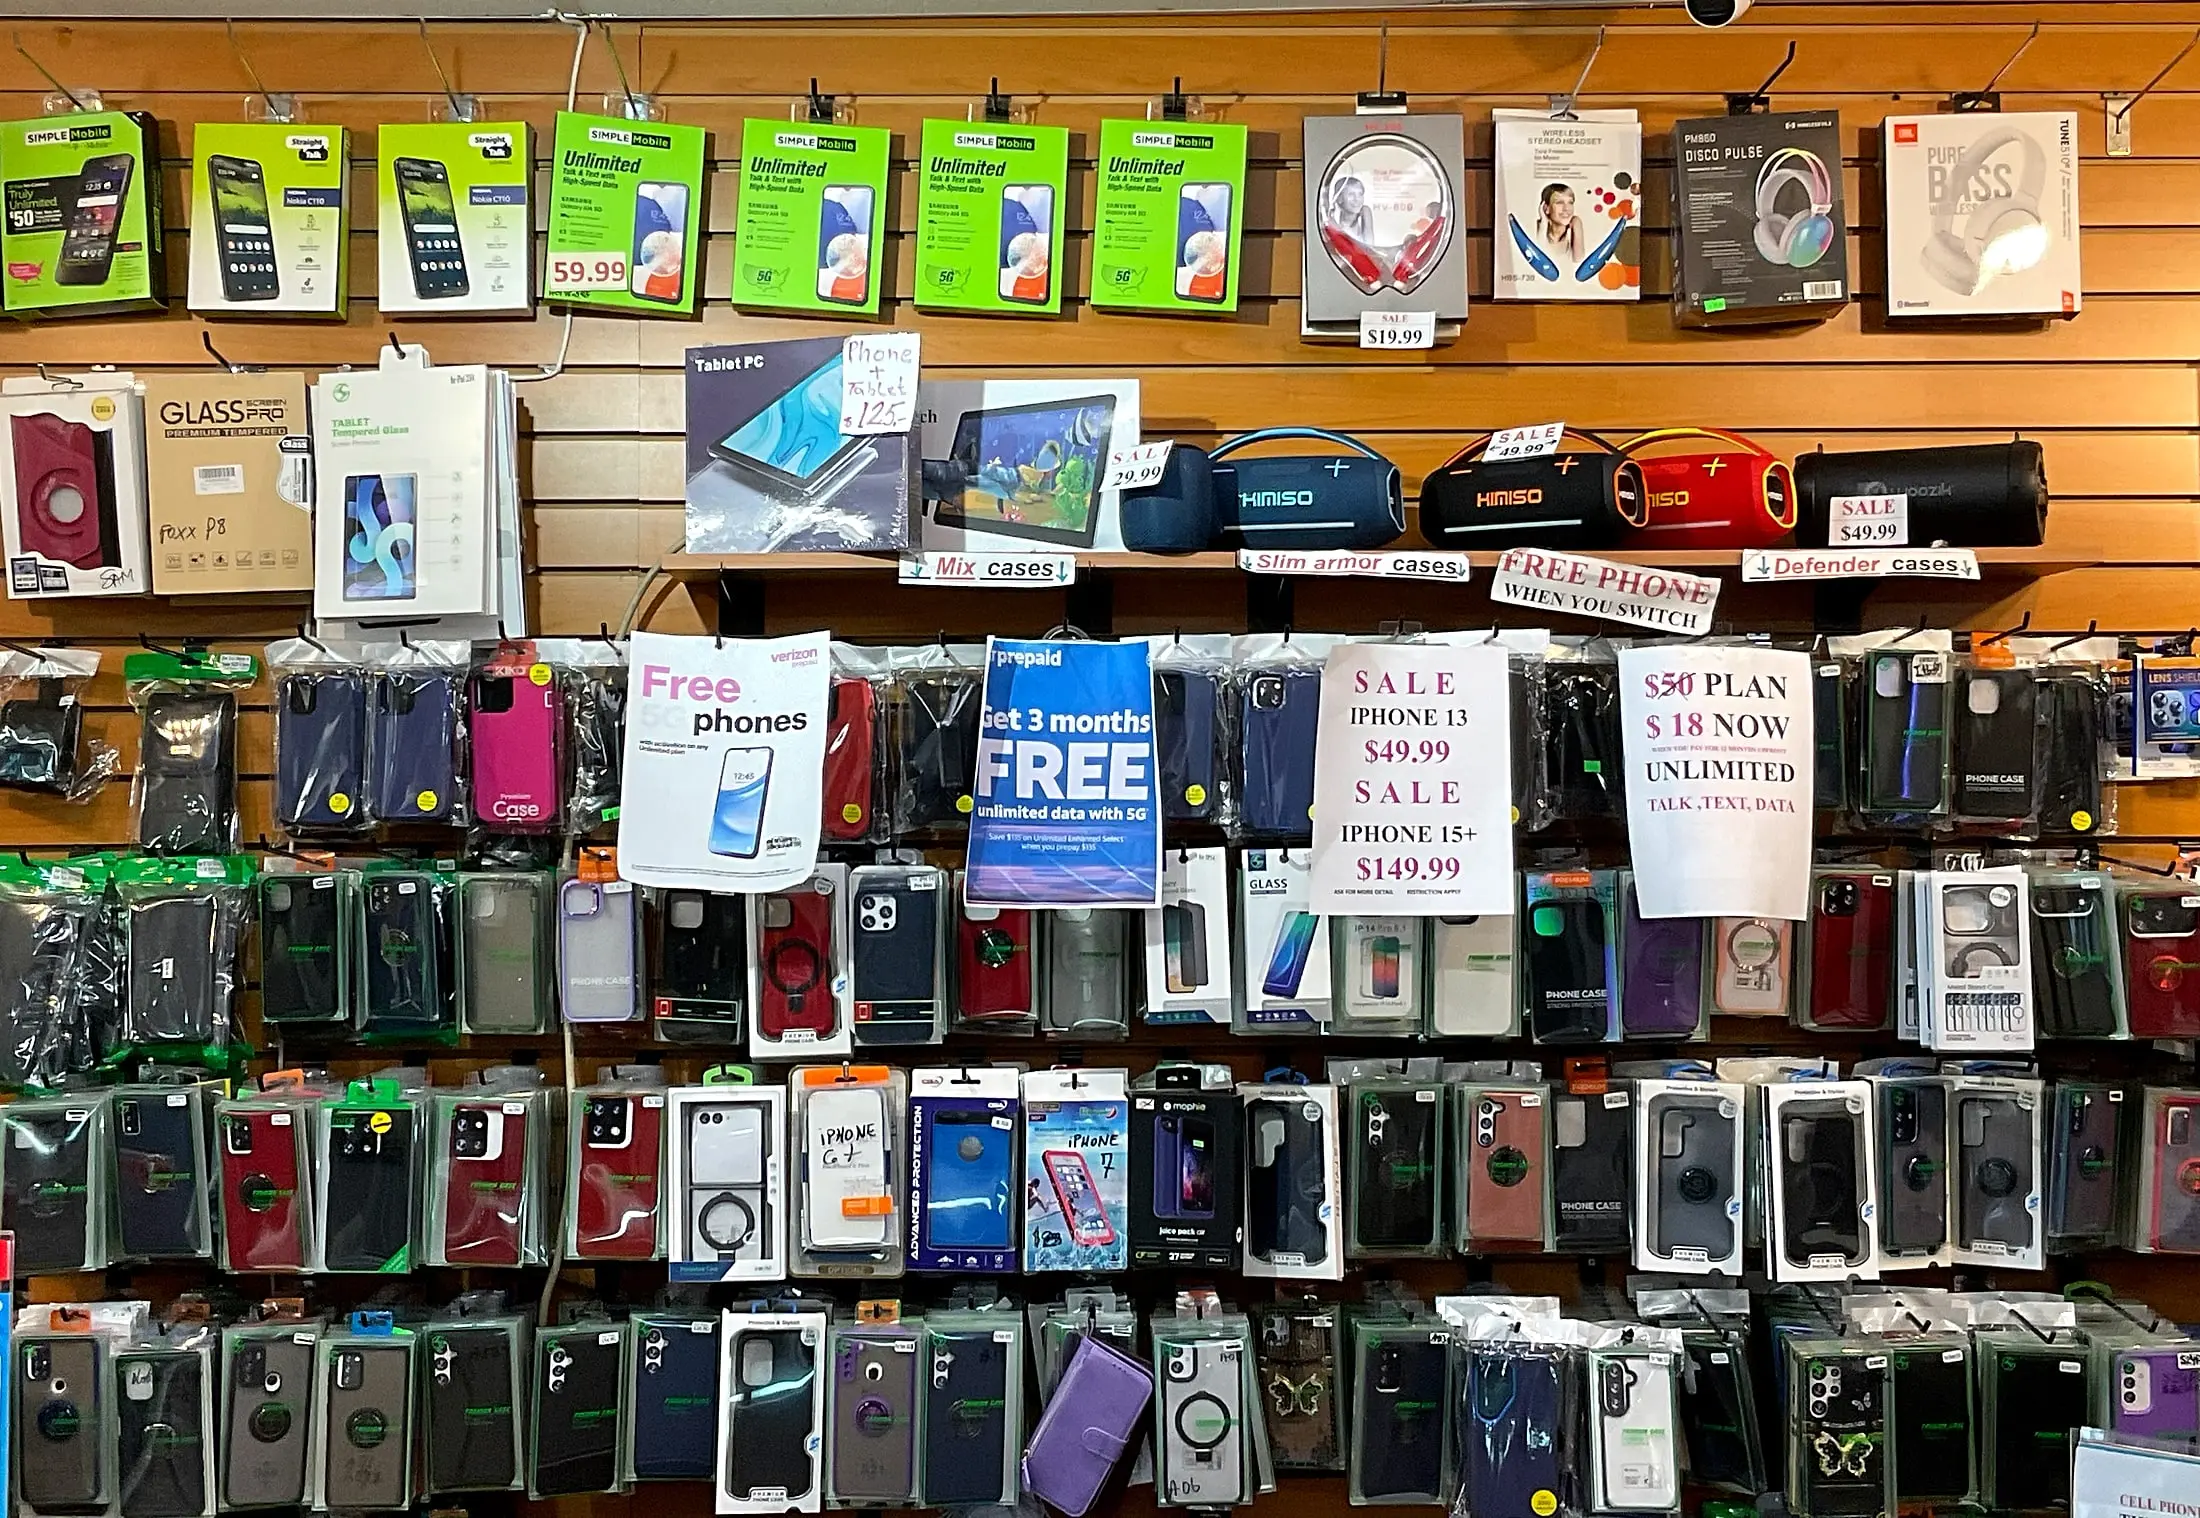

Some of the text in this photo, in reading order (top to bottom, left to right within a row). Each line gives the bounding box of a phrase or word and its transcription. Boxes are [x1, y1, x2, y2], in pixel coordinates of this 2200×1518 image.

[27, 127, 109, 144] SIMPLE Mobile
[591, 129, 669, 148] SIMPLE Mobile
[1542, 129, 1586, 137] WIRELESS
[292, 138, 323, 149] Straight
[475, 136, 505, 147] Straight
[777, 135, 855, 150] SIMPLE Mobile
[956, 135, 1034, 150] SIMPLE Mobile
[1135, 135, 1212, 149] SIMPLE Mobile
[1527, 137, 1602, 145] STEREO HEADSET
[1685, 145, 1763, 162] DISCO PULSE
[564, 150, 642, 174] Unlimited
[750, 157, 827, 178] Unlimited
[930, 156, 1006, 177] Unlimited
[1109, 156, 1185, 176] Unlimited
[562, 168, 576, 177] Talk
[585, 170, 600, 179] Text
[749, 174, 763, 183] Talk
[772, 175, 787, 184] Text
[929, 174, 943, 183] Talk
[952, 176, 966, 185] Text
[1107, 174, 1121, 183] Talk
[1129, 175, 1144, 184] Text
[562, 176, 618, 189] High-Speed Data
[749, 182, 805, 194] High-Speed Data
[929, 183, 985, 193] High-Speed Data
[1107, 183, 1162, 193] High-Speed Data
[8, 188, 34, 200] Truly
[287, 196, 325, 206] Nokia C110
[472, 194, 510, 203] Nokia C110
[9, 197, 58, 210] Unlimited
[554, 261, 625, 283] 59.99
[757, 271, 773, 282] 5G
[939, 271, 954, 282] 5G
[1115, 271, 1131, 282] 5G
[1382, 314, 1409, 323] SALE
[1367, 329, 1423, 345] $19.99
[848, 340, 912, 364] Phone
[695, 354, 765, 372] Tablet PC
[869, 365, 885, 380] +
[160, 400, 245, 425] GLASS
[246, 408, 285, 421] PRO
[331, 418, 370, 428] TABLET
[166, 427, 287, 438] PREMIUM TEMPERED
[331, 425, 409, 439] Tempered Glass
[1498, 426, 1558, 444] SALE
[1498, 443, 1544, 458] 49.99
[1111, 466, 1161, 487] 29.99
[1842, 499, 1896, 516] SALE
[1840, 523, 1897, 541] $49.99
[935, 556, 1055, 577] Mix cases
[1256, 554, 1457, 575] Slim armor cases
[1774, 556, 1958, 575] Defender cases
[1502, 548, 1712, 605] FREE PHONE
[1503, 582, 1698, 628] WHEN YOU SWITCH
[771, 648, 818, 663] verizon
[997, 649, 1062, 668] prepaid
[641, 664, 742, 704] Free
[1354, 669, 1456, 695] SALE
[1645, 671, 1788, 700] $50 PLAN
[2149, 673, 2172, 683] LENS
[693, 708, 808, 736] phones
[983, 706, 1151, 733] Get 3 months
[1350, 706, 1468, 726] IPHONE 13
[1672, 712, 1704, 737] 18
[1713, 713, 1790, 740] NOW
[1365, 739, 1451, 764] $49.99
[977, 737, 1150, 801] FREE
[1645, 759, 1795, 783] UNLIMITED
[1966, 775, 2025, 783] PHONE CASE
[1355, 780, 1461, 804] SALE
[493, 801, 539, 818] Case
[977, 804, 1147, 821] unlimited data with 5G
[1647, 797, 1692, 812] TALK
[1756, 798, 1795, 813] DATA
[988, 832, 1005, 841] Save
[1341, 825, 1478, 843] IPHONE 15+
[1041, 845, 1055, 853] you
[1057, 844, 1080, 853] prepay
[1356, 857, 1461, 882] $149.99
[1249, 878, 1287, 889] GLASS
[1554, 876, 1590, 884] PREMIUM
[1546, 989, 1607, 999] PHONE CASE
[1173, 1102, 1206, 1112] mophie
[1068, 1134, 1119, 1148] iPHONE
[910, 1105, 922, 1260] ADVANCED PROTECTION
[1561, 1202, 1621, 1210] PHONE CASE
[1159, 1227, 1196, 1237] juice pack
[2119, 1494, 2200, 1517] CELL PHON
